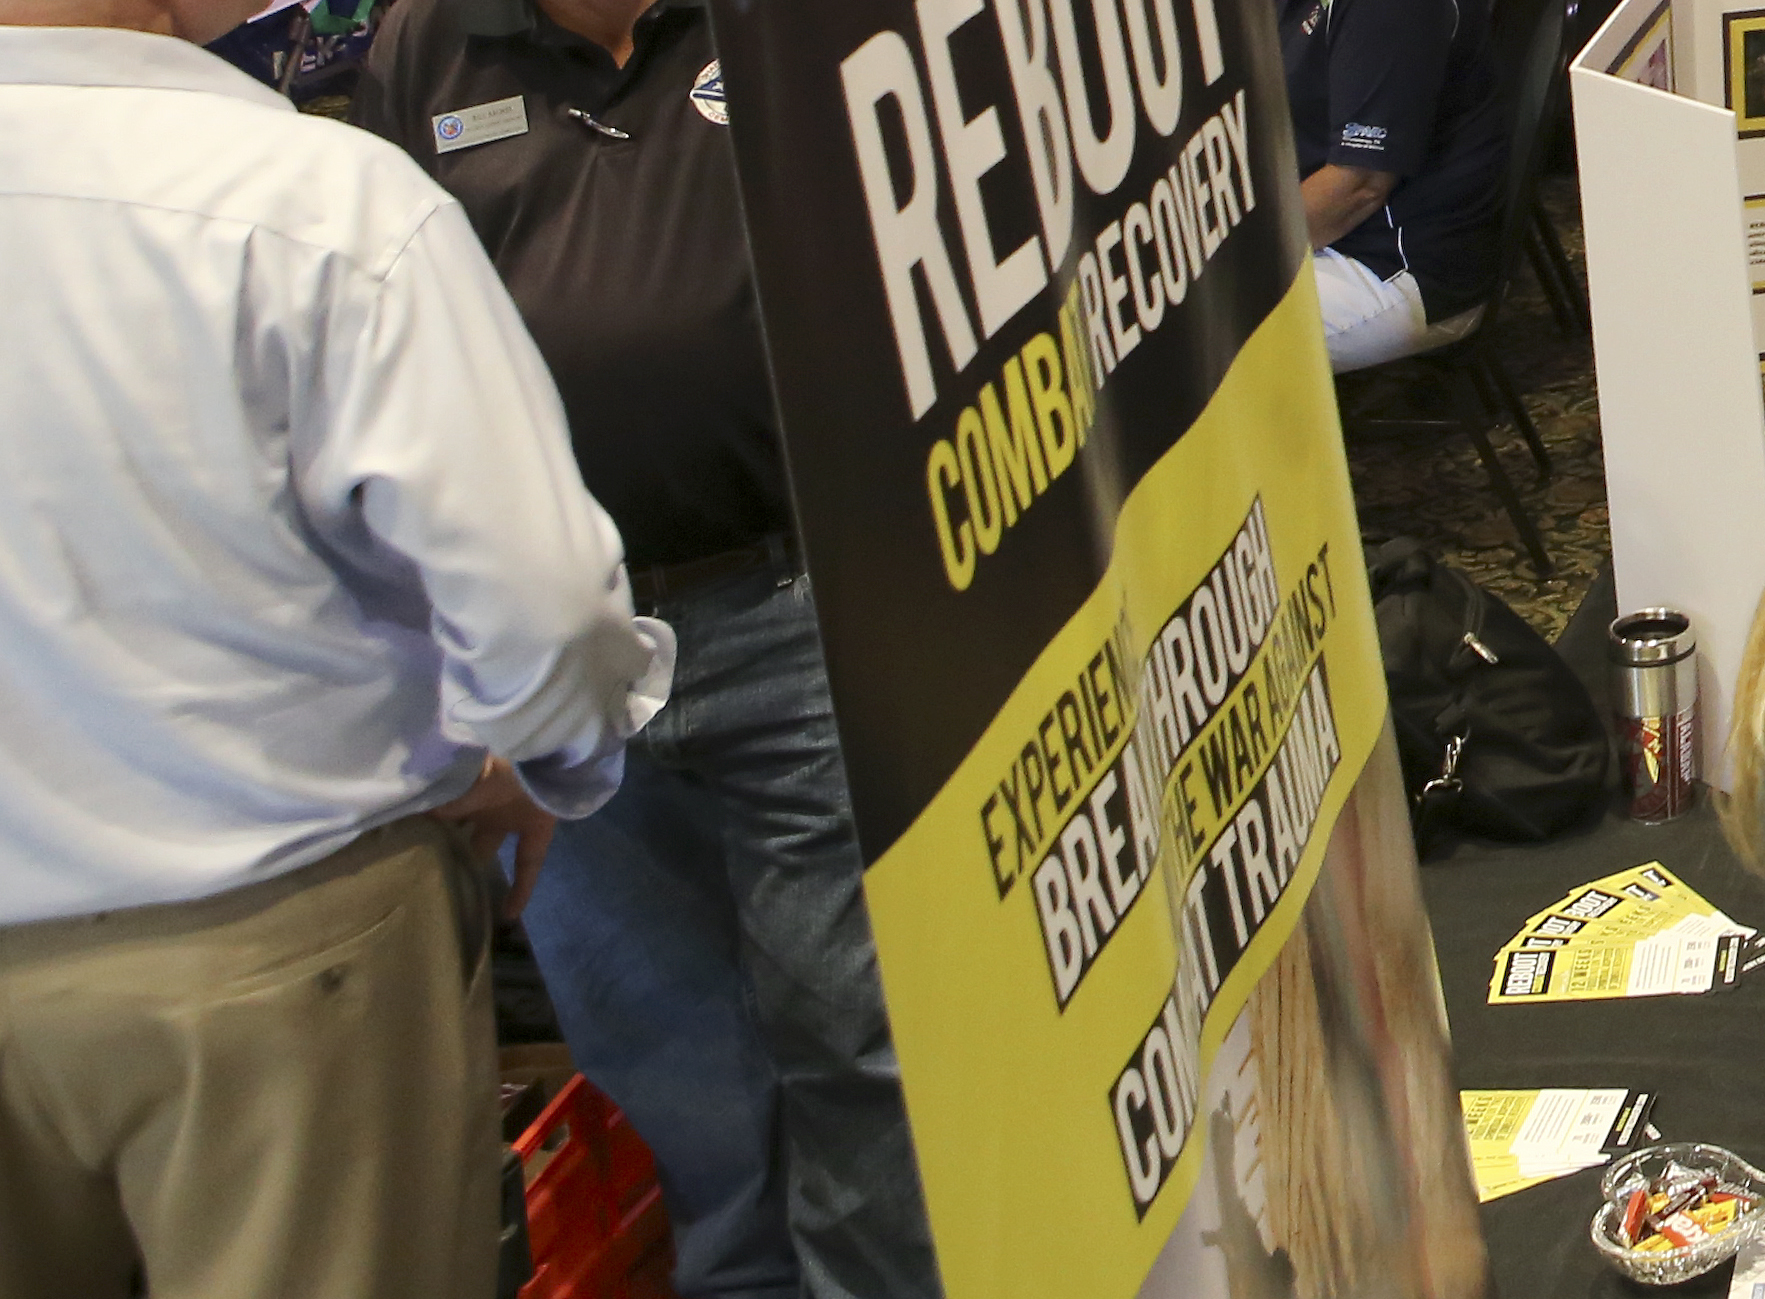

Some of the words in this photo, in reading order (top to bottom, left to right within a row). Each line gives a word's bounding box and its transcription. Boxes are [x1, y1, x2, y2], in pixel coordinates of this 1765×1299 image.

[926, 276, 1097, 591] COMBAT
[1078, 89, 1257, 390] RECOVERY
[980, 587, 1139, 903] EXPERIEN
[1032, 501, 1280, 1004] BREAHROUGH
[1199, 679, 1268, 822] WAR
[1262, 542, 1338, 742] AGAINST
[1117, 864, 1220, 1204] COMAT
[1211, 664, 1341, 949] TRAUMA
[1504, 952, 1539, 995] REBOOT
[1571, 981, 1586, 992] 12
[1573, 949, 1592, 978] WEEKS
